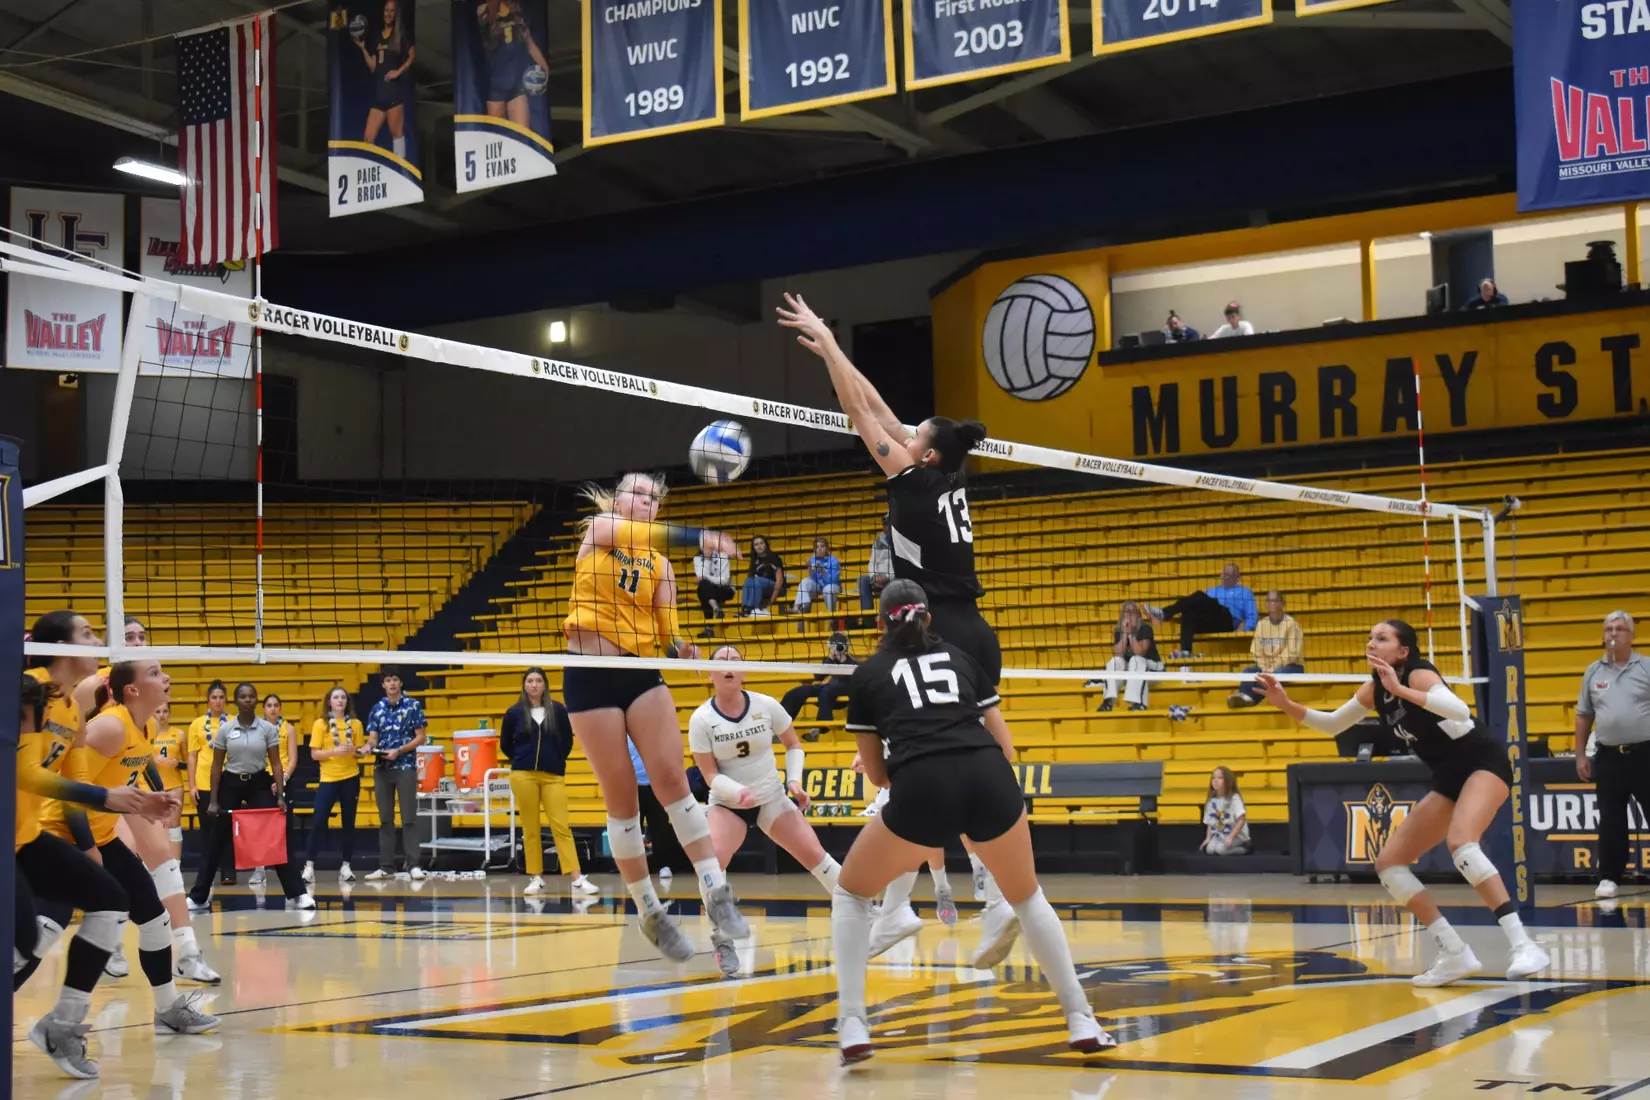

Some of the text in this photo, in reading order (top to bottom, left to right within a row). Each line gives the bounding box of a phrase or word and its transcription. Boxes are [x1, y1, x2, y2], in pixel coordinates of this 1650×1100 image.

[791, 5, 840, 35] NIVC
[935, 0, 975, 18] First
[1142, 0, 1219, 21] 20
[953, 19, 1024, 57] 2003
[626, 38, 678, 66] WIVC
[785, 53, 850, 88] 1992
[625, 84, 684, 117] 1989
[1551, 76, 1650, 161] VAL
[485, 141, 503, 160] LILY
[357, 166, 381, 185] PAIGE
[465, 151, 476, 182] 5
[486, 158, 516, 179] EVANS
[1559, 157, 1650, 177] MISSOURI VALLE
[338, 175, 348, 205] 2
[357, 183, 387, 203] BROCK
[24, 309, 107, 351] VALLEY
[51, 312, 77, 322] THE
[264, 307, 396, 348] RACER VOLLEYBALL
[156, 317, 236, 358] VALLEY
[543, 361, 649, 394] RACER VOLLEYBALL
[1131, 333, 1649, 457] MURRAY ST
[762, 403, 846, 428] RACER VOLLEYBALL
[1082, 458, 1138, 476] RACER VOLLEYBALL
[937, 487, 974, 543] 13
[618, 567, 640, 594] 11
[891, 652, 960, 710] 15
[714, 724, 766, 742] MURRAY STATE
[160, 746, 168, 758] 4
[458, 745, 469, 762] G
[736, 740, 750, 758] 3
[1505, 665, 1529, 903] RACERS
[1473, 1078, 1617, 1095] TM
